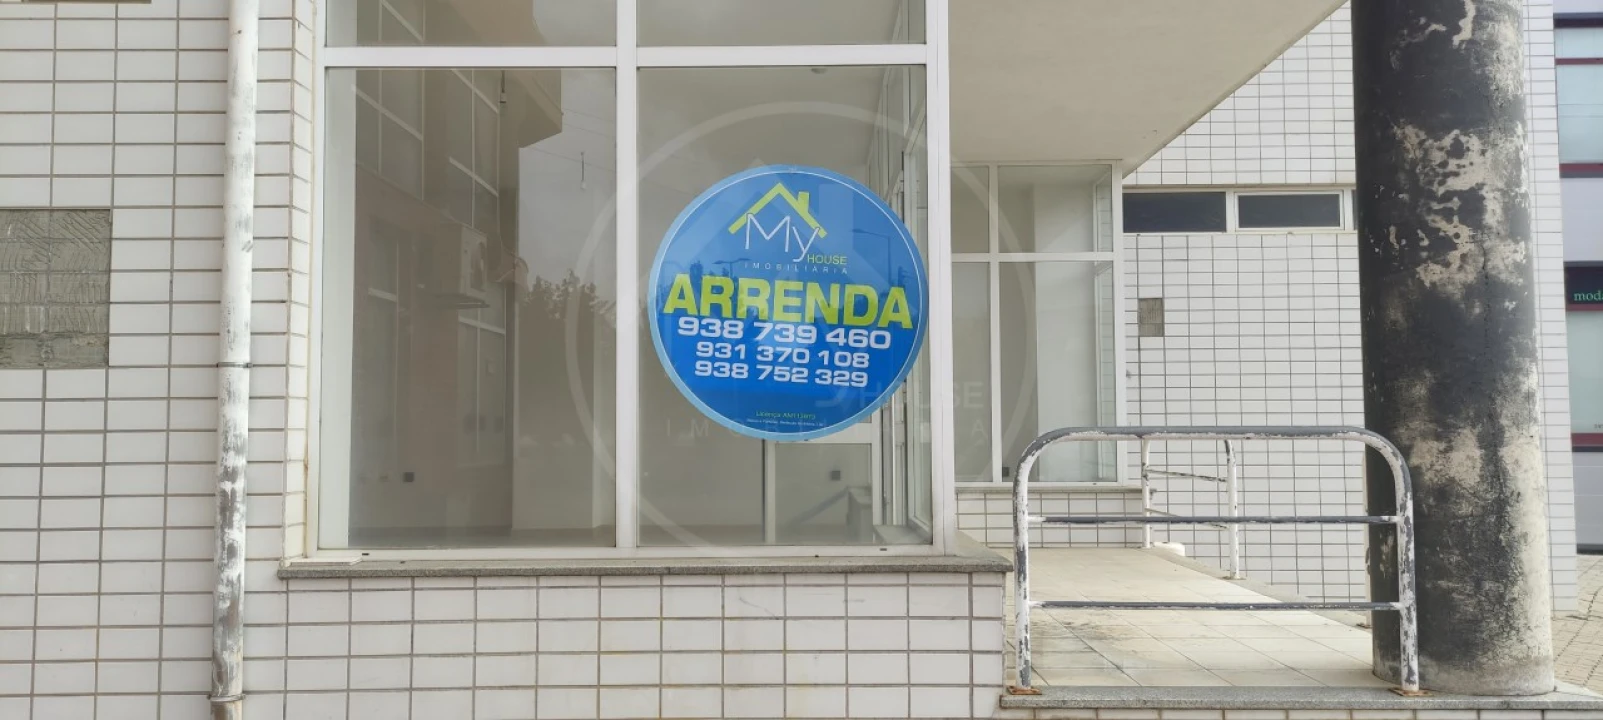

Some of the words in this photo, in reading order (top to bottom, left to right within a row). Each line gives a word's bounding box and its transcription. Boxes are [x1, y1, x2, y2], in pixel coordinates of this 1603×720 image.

[744, 213, 821, 262] My
[806, 253, 848, 265] HOUSE
[663, 273, 913, 329] ARRENDA
[1573, 290, 1603, 302] mod
[677, 316, 744, 339] 938
[753, 321, 817, 344] 739
[825, 327, 891, 349] 460
[696, 341, 746, 360] 931
[756, 346, 810, 364] 370
[818, 350, 869, 368] 108
[694, 360, 749, 379] 938
[756, 365, 809, 382] 752
[814, 369, 868, 388] 329
